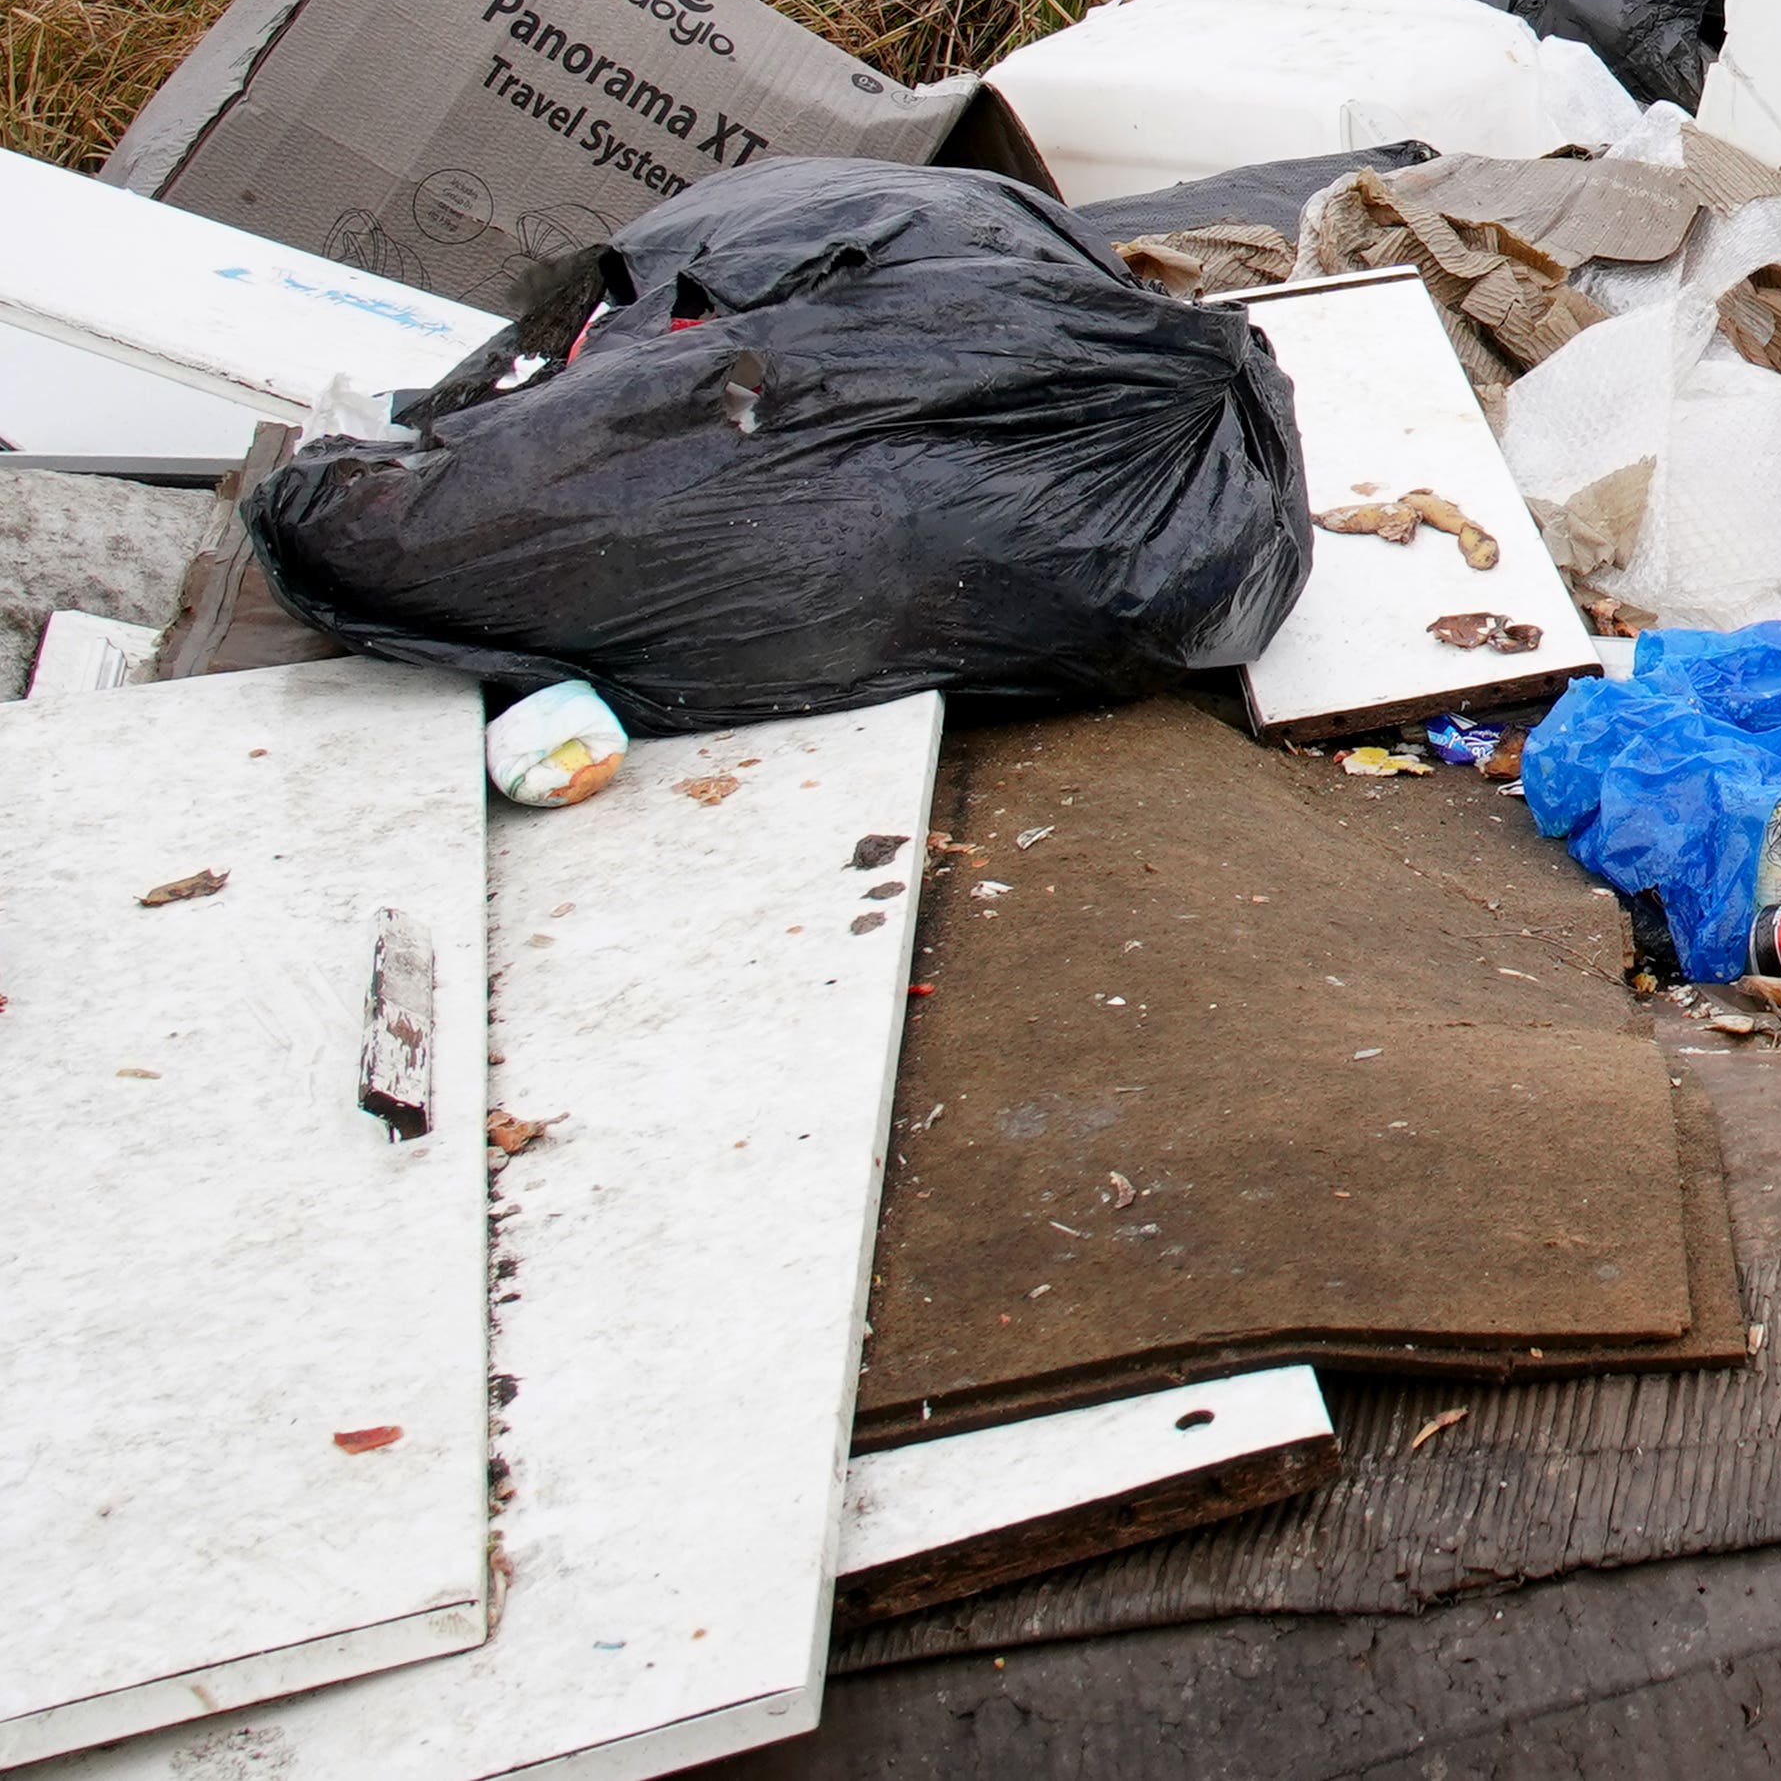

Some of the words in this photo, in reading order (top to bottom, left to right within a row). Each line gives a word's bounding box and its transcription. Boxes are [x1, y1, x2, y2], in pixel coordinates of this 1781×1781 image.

[479, 54, 587, 141] Travel
[579, 119, 696, 201] System
[696, 109, 770, 168] XT
